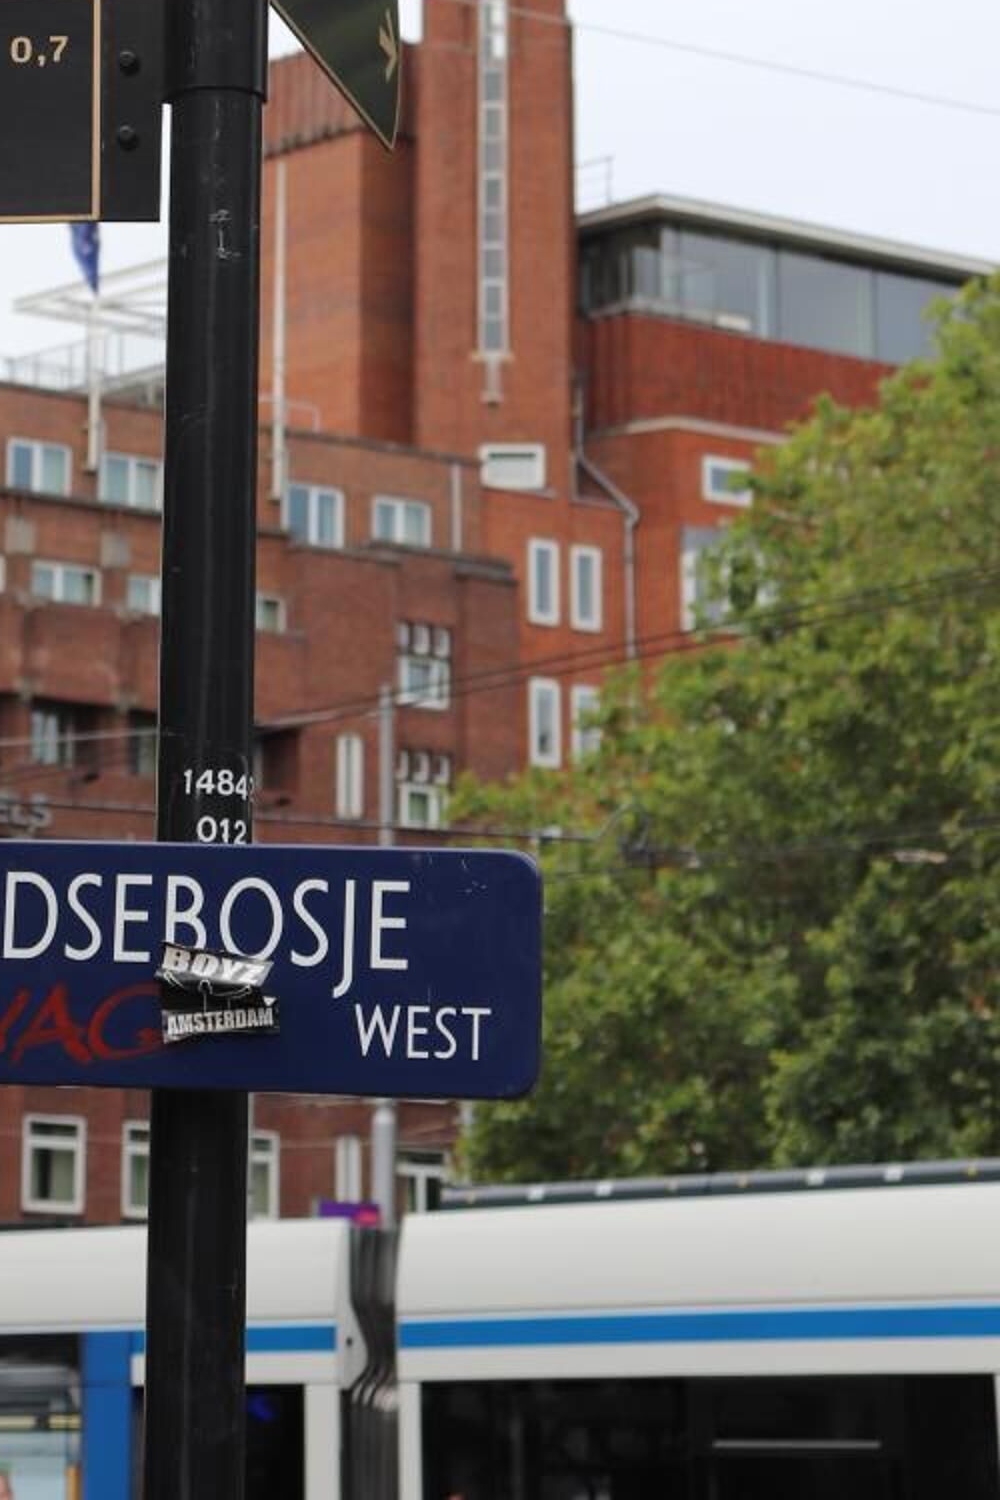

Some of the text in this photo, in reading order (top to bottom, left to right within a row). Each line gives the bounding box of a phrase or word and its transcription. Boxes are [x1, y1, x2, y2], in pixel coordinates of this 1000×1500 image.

[10, 35, 69, 66] 0,7
[196, 816, 247, 846] 012
[167, 1007, 274, 1036] AMSTERDAM
[355, 1003, 492, 1060] WEST
